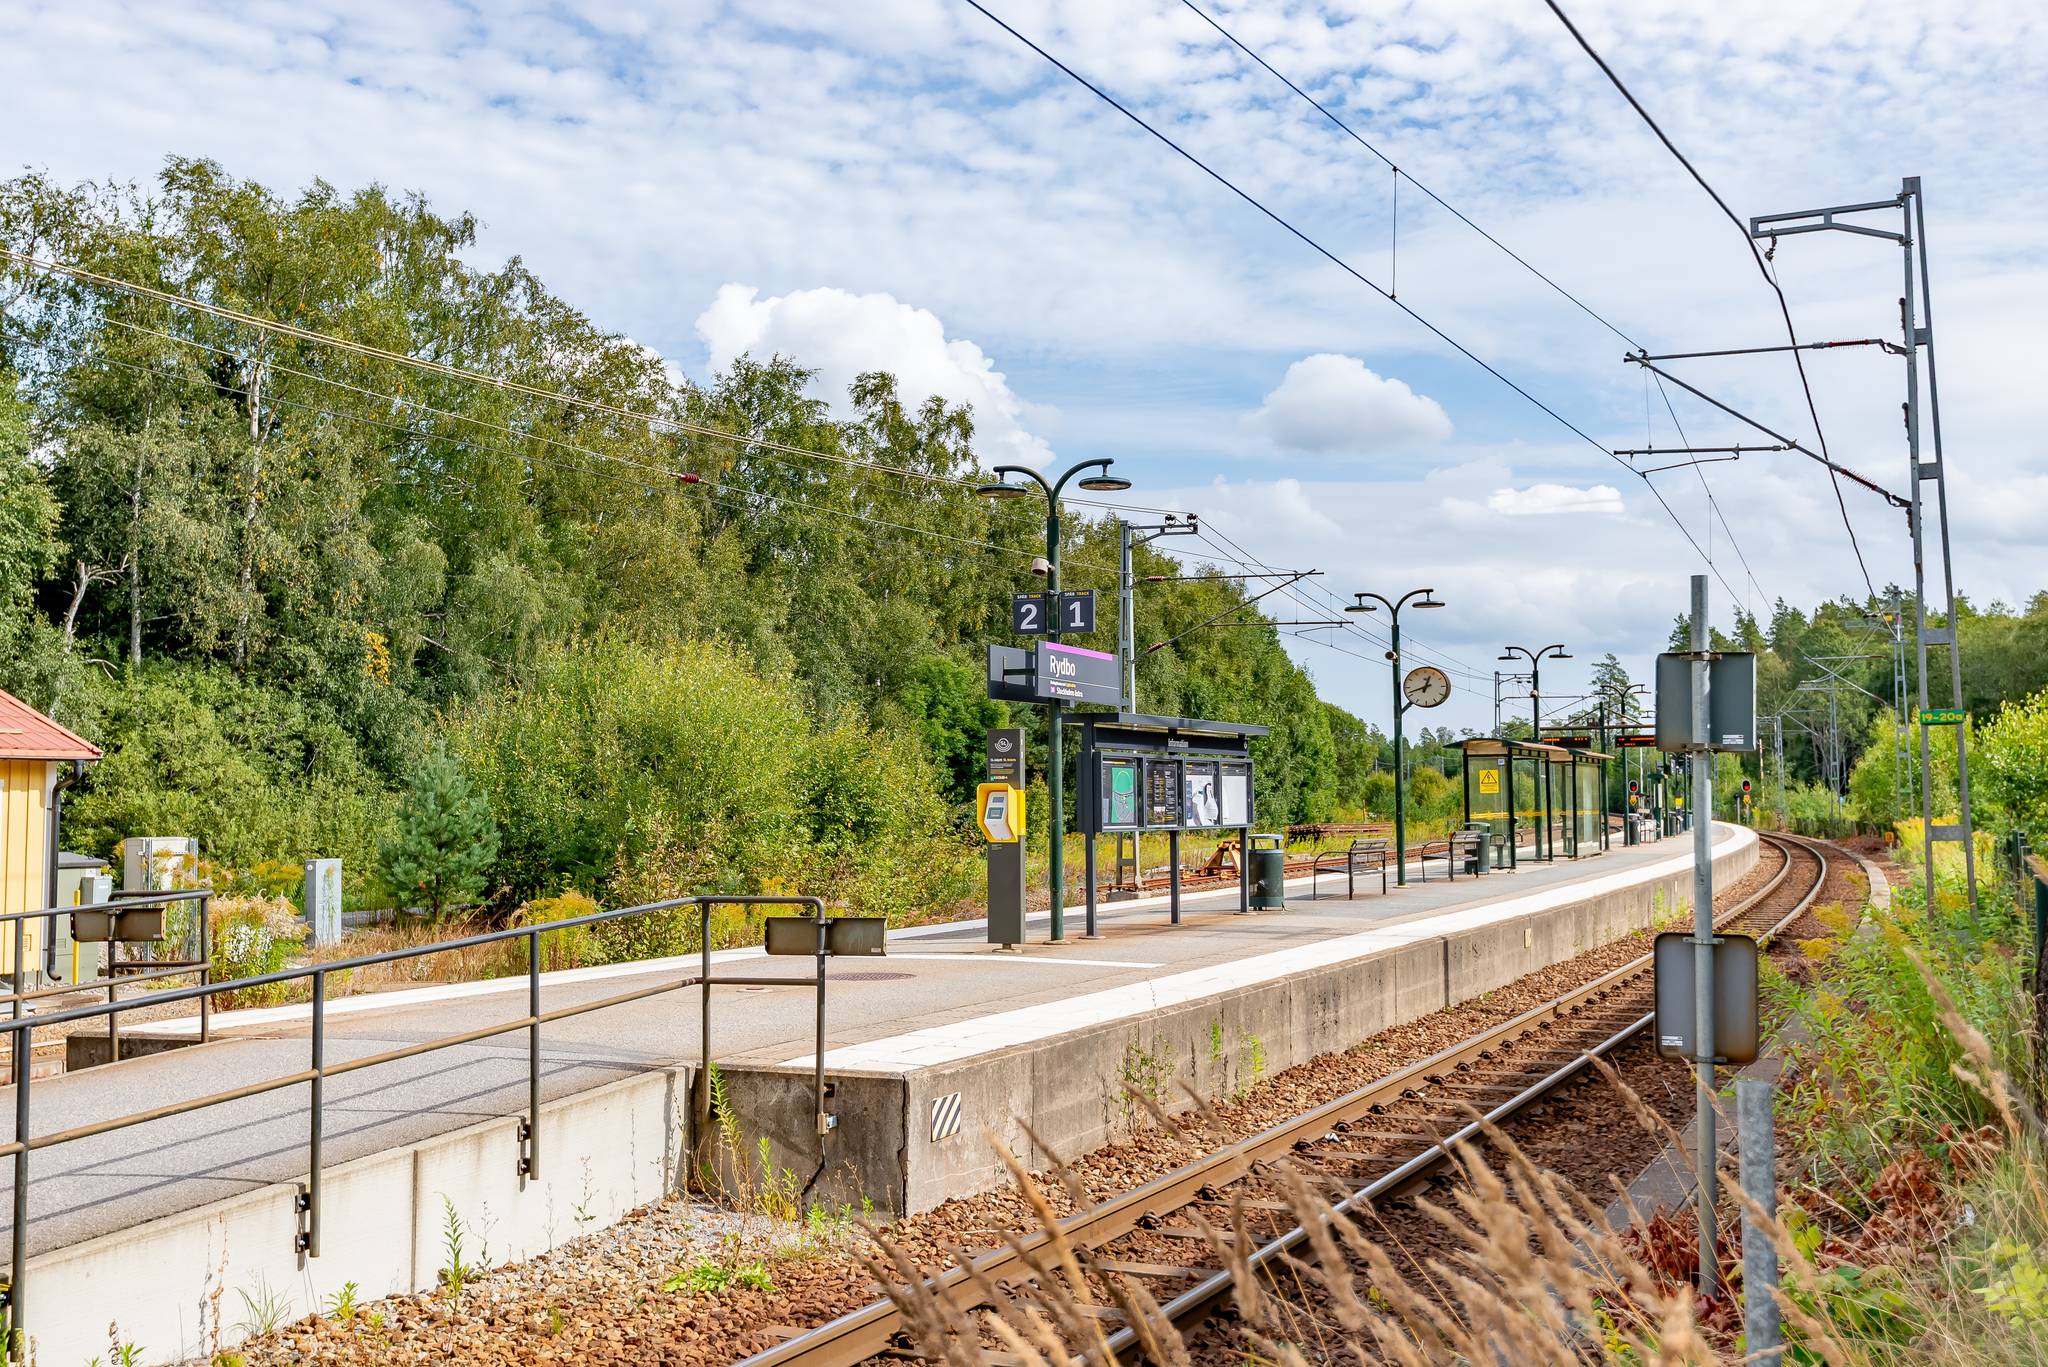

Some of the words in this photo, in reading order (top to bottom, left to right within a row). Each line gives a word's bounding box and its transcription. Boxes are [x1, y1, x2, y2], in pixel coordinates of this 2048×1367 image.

[1020, 603, 1038, 630] 2
[1069, 601, 1085, 627] 1
[1049, 655, 1076, 678] Rydbo
